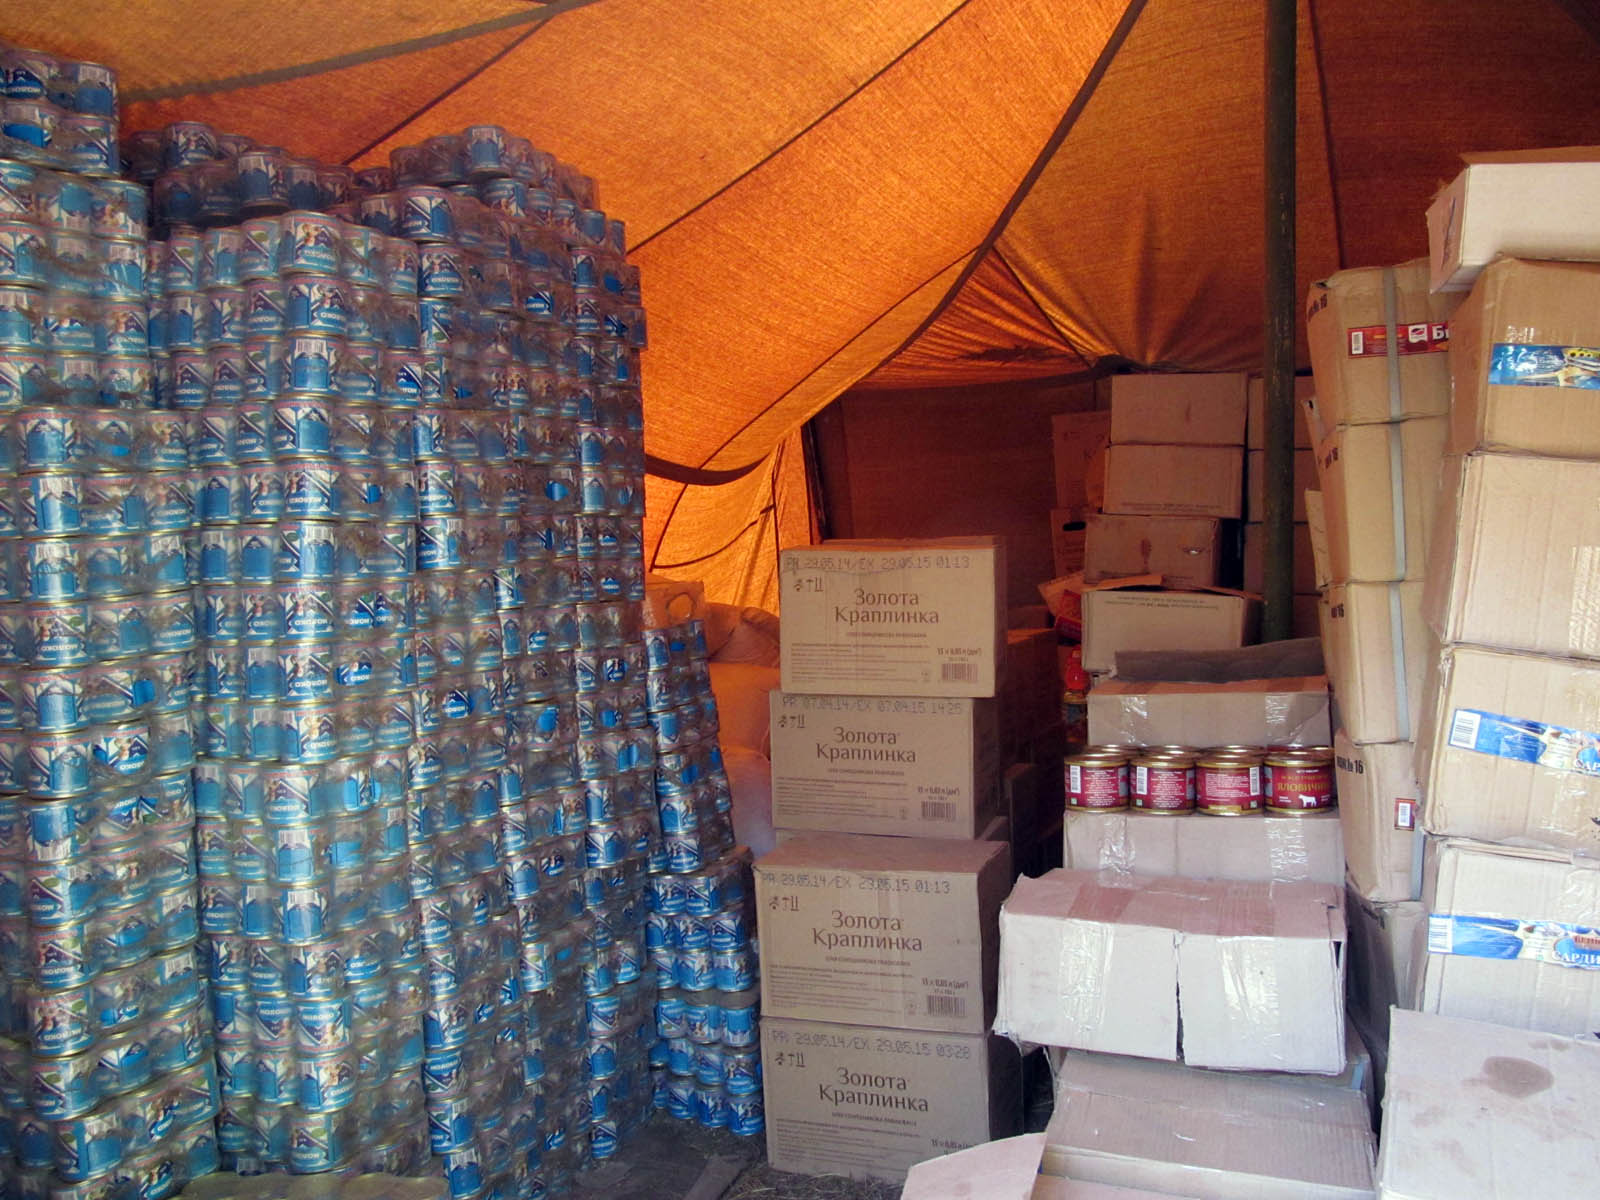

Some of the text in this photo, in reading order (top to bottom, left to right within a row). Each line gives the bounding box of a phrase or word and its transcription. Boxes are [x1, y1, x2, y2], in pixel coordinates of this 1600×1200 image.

[854, 588, 919, 606] Золота
[834, 606, 939, 626] Краплинка
[833, 726, 897, 744] Золота
[816, 743, 917, 763] Краплинка
[831, 910, 901, 931] Золота
[812, 928, 923, 951] Краплинка
[837, 1067, 907, 1090] Золота
[819, 1084, 929, 1112] Краплинка
